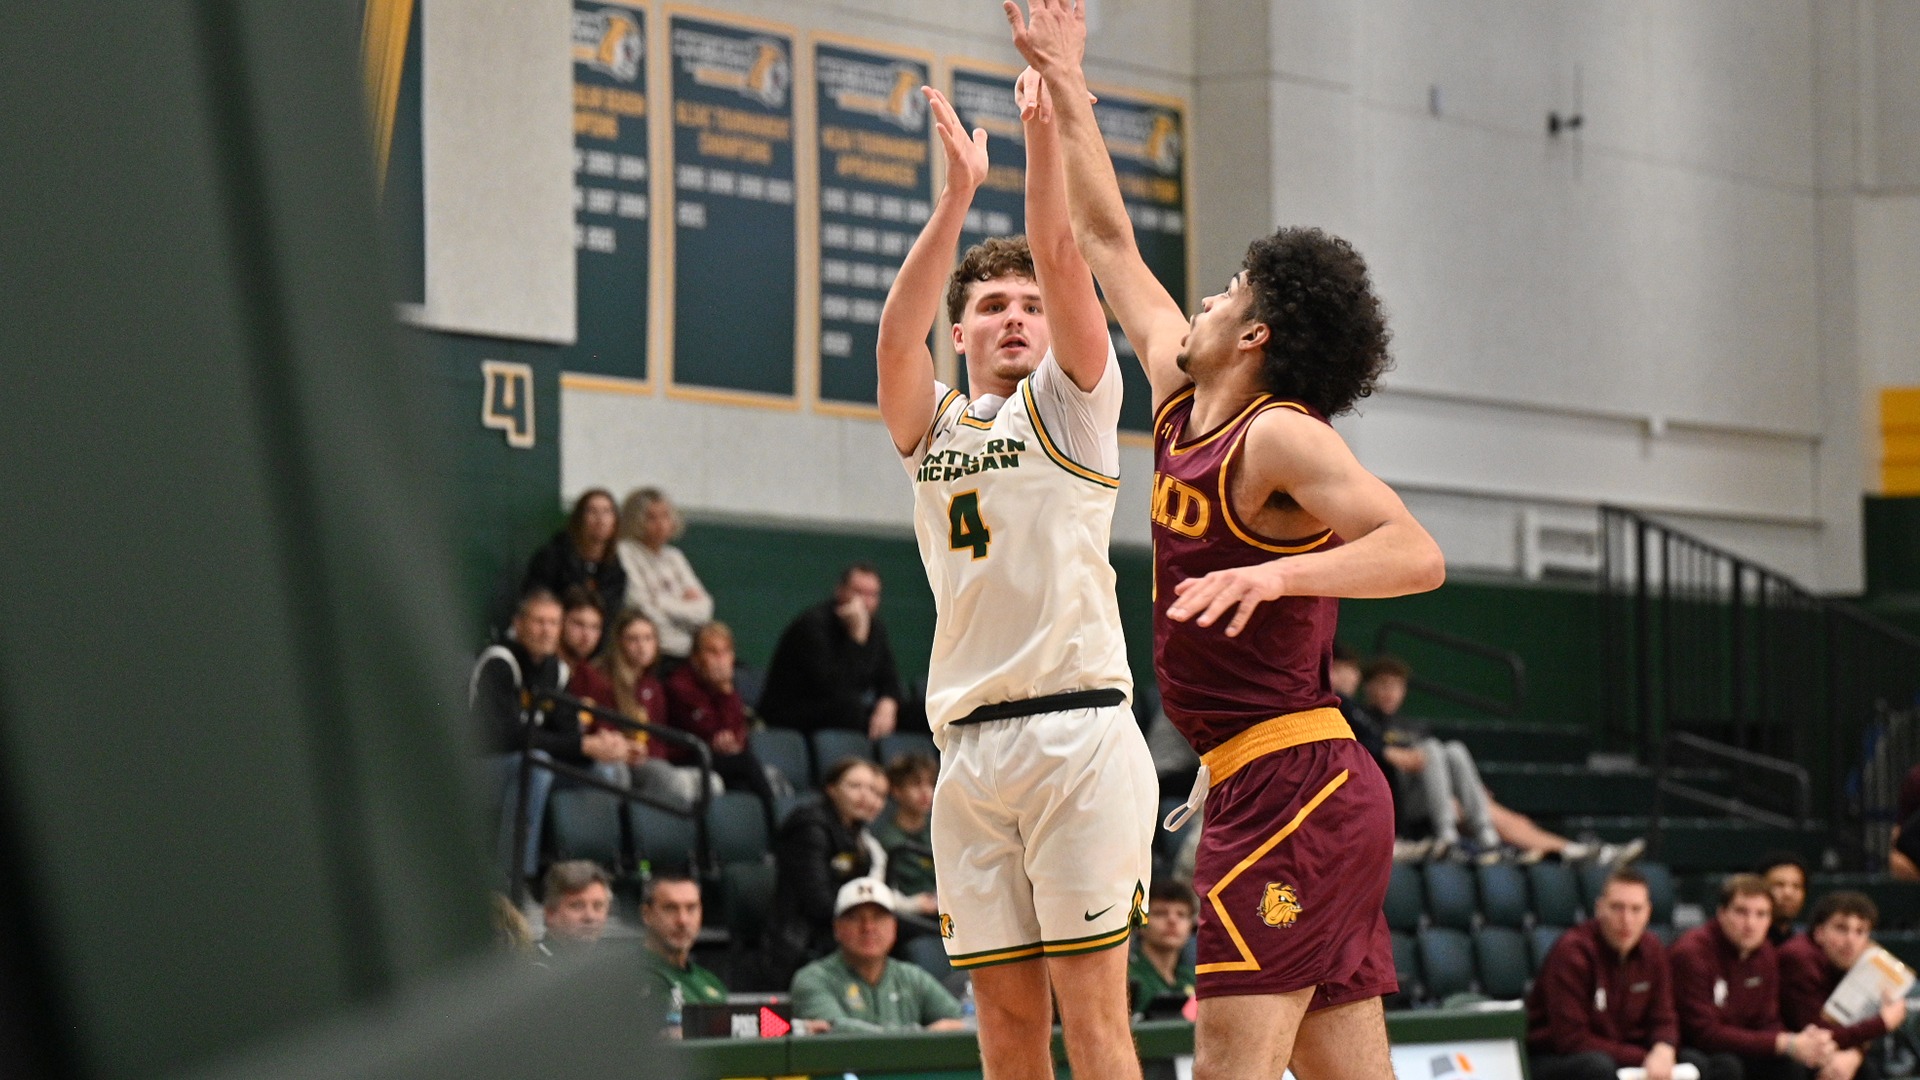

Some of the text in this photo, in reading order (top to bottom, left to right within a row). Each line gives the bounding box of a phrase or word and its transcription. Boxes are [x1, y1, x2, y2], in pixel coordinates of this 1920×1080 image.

[482, 360, 534, 448] 4
[947, 488, 992, 562] 4
[1151, 471, 1211, 539] MD
